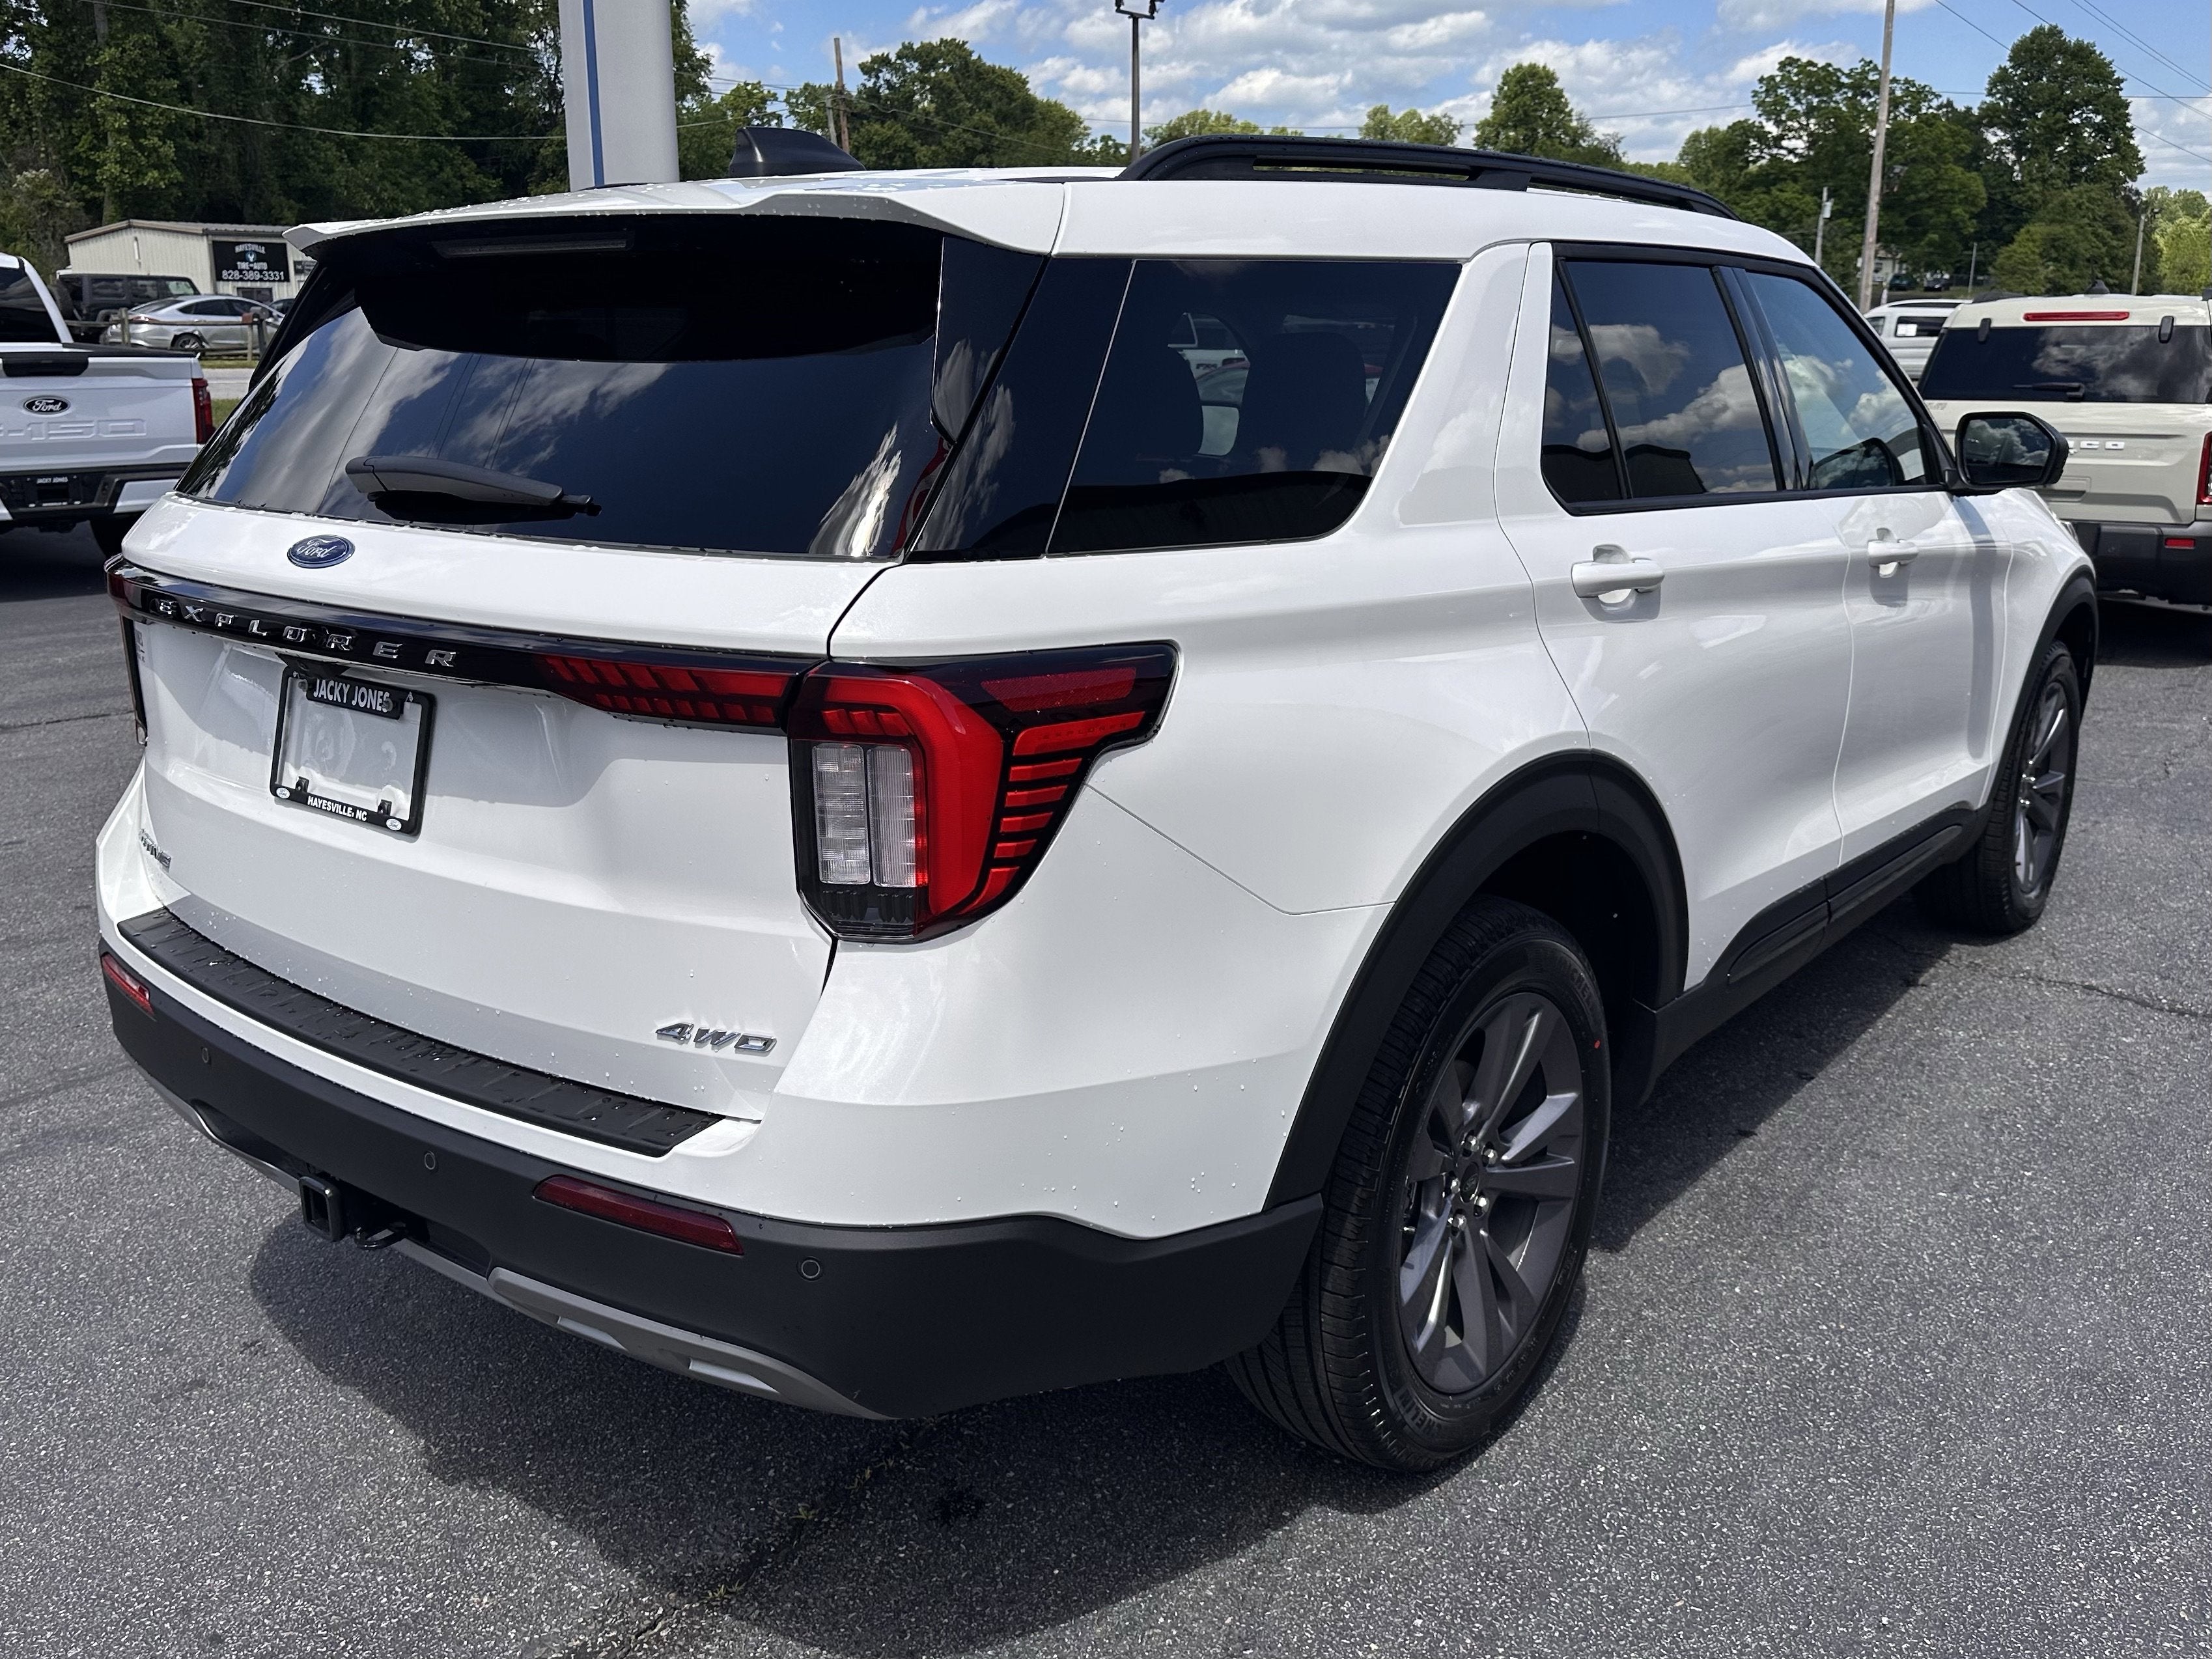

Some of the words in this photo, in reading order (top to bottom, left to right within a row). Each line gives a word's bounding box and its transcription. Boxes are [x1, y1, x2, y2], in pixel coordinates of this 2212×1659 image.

[222, 270, 284, 281] 828-389-3331
[0, 419, 147, 440] -150
[158, 599, 456, 668] EXPLORER
[313, 678, 350, 703] JACKY
[352, 686, 391, 713] JONES
[307, 795, 355, 818] HAYESVILLE,
[356, 809, 367, 822] NC
[655, 1022, 777, 1053] 4WD
